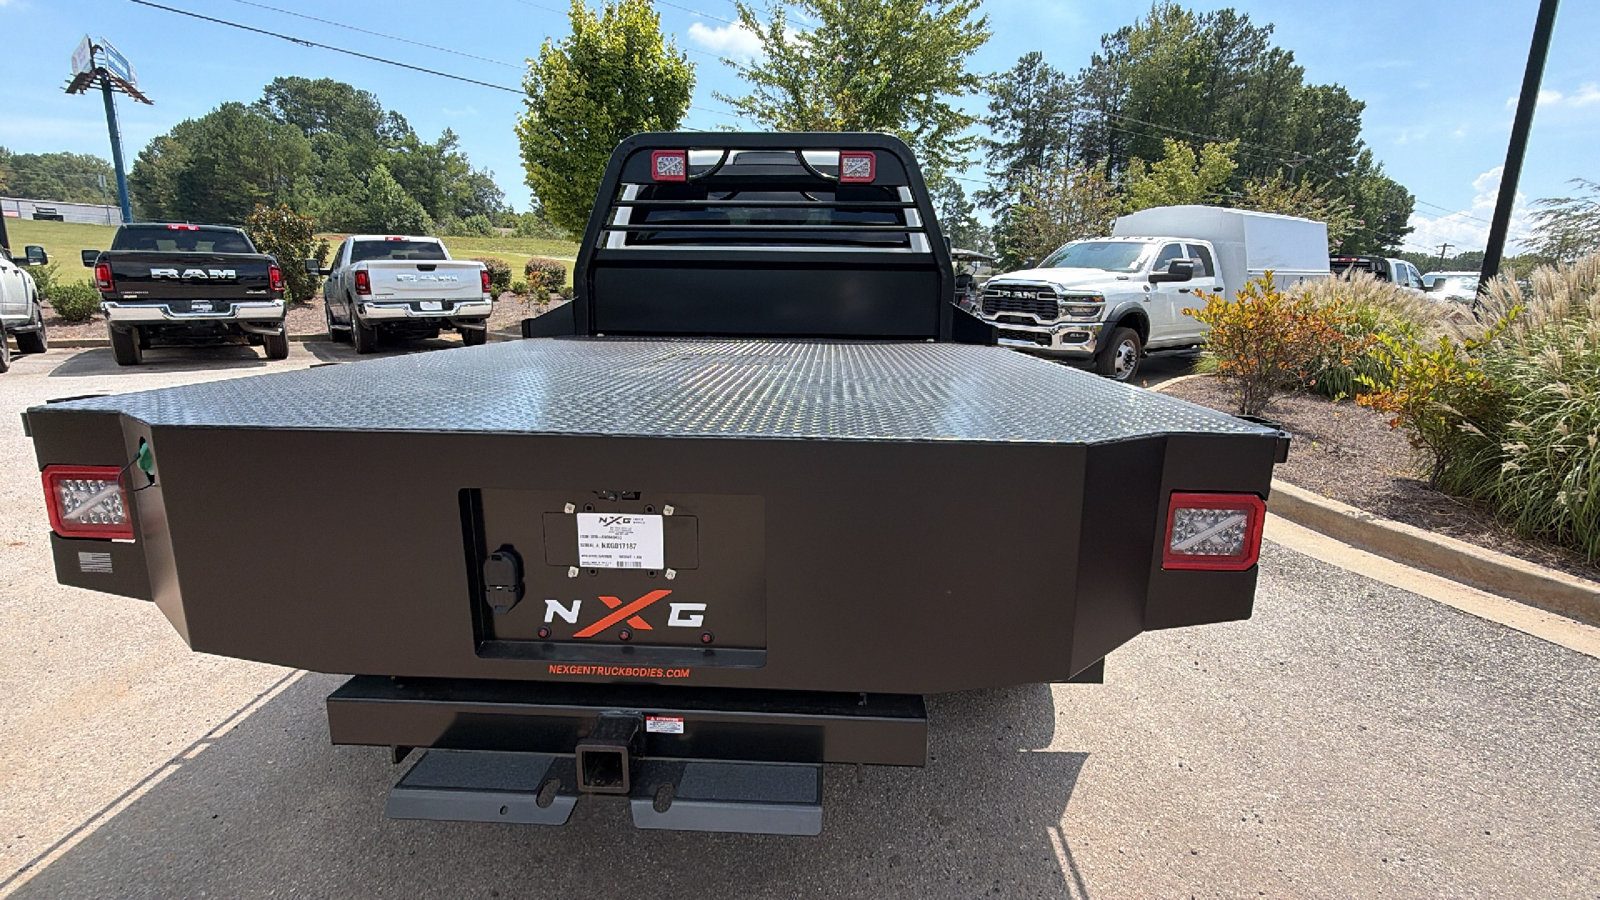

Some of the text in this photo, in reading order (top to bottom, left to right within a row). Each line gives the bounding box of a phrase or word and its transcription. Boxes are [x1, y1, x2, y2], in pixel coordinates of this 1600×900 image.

[150, 268, 237, 279] RAM
[396, 274, 458, 282] RAM
[598, 516, 632, 527] NXG
[544, 589, 707, 638] NXG
[548, 664, 690, 678] NEXGENTRUCKBODIES.COM
